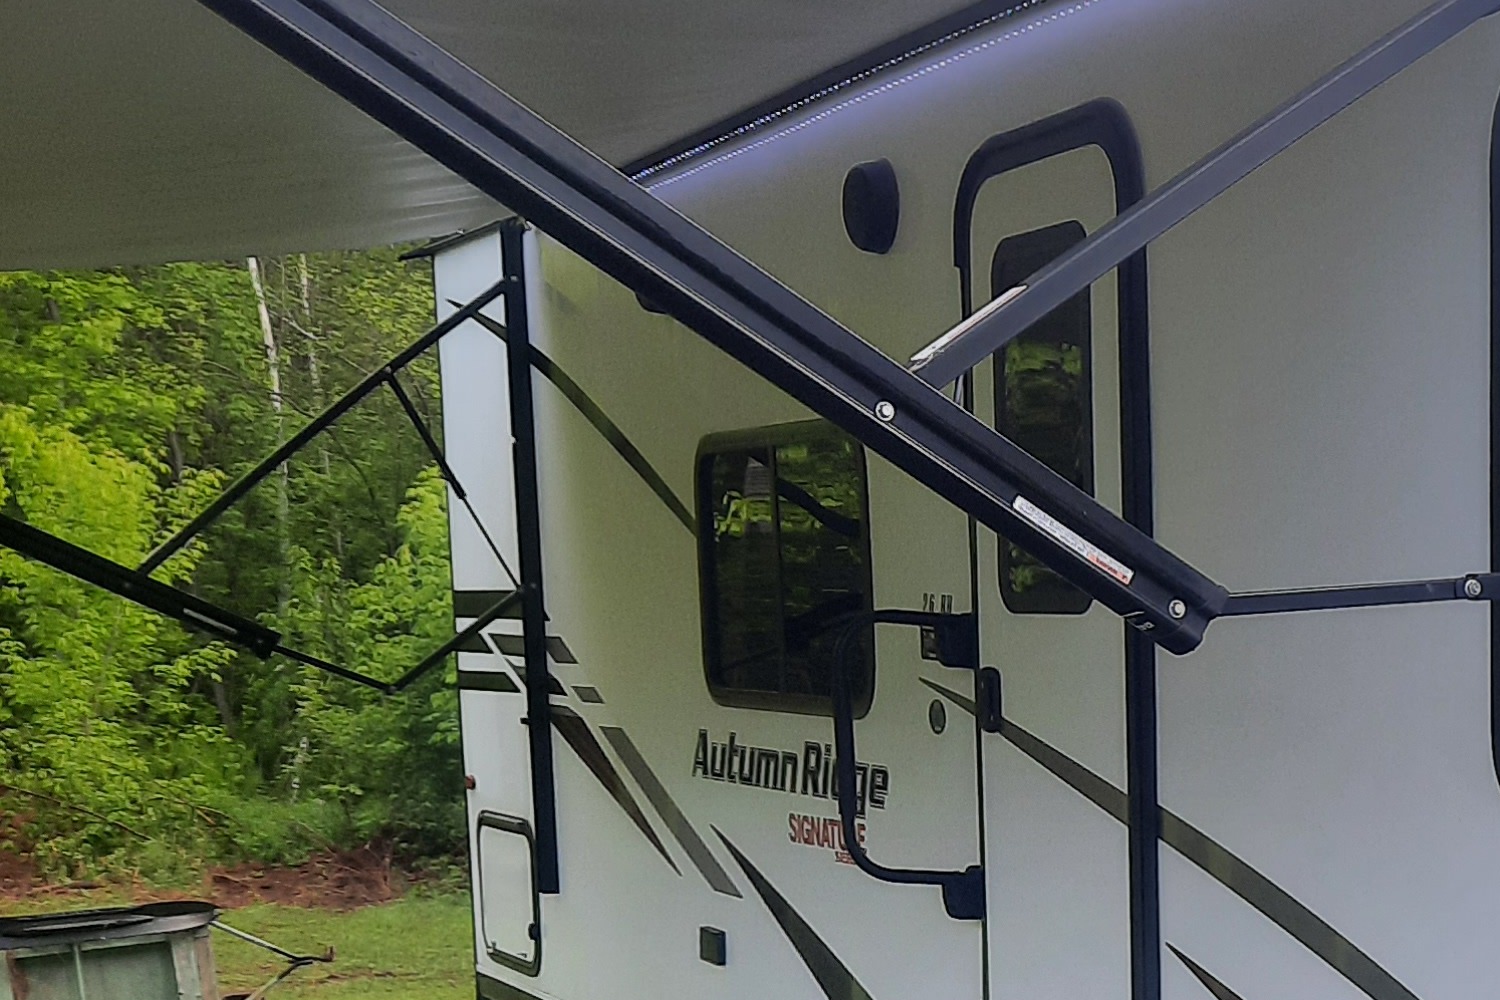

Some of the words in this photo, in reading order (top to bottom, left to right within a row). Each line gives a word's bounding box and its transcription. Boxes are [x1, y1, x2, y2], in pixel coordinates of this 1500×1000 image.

[692, 728, 798, 793] Autumn
[801, 740, 889, 819] Rige
[788, 813, 866, 855] SIGNATUE
